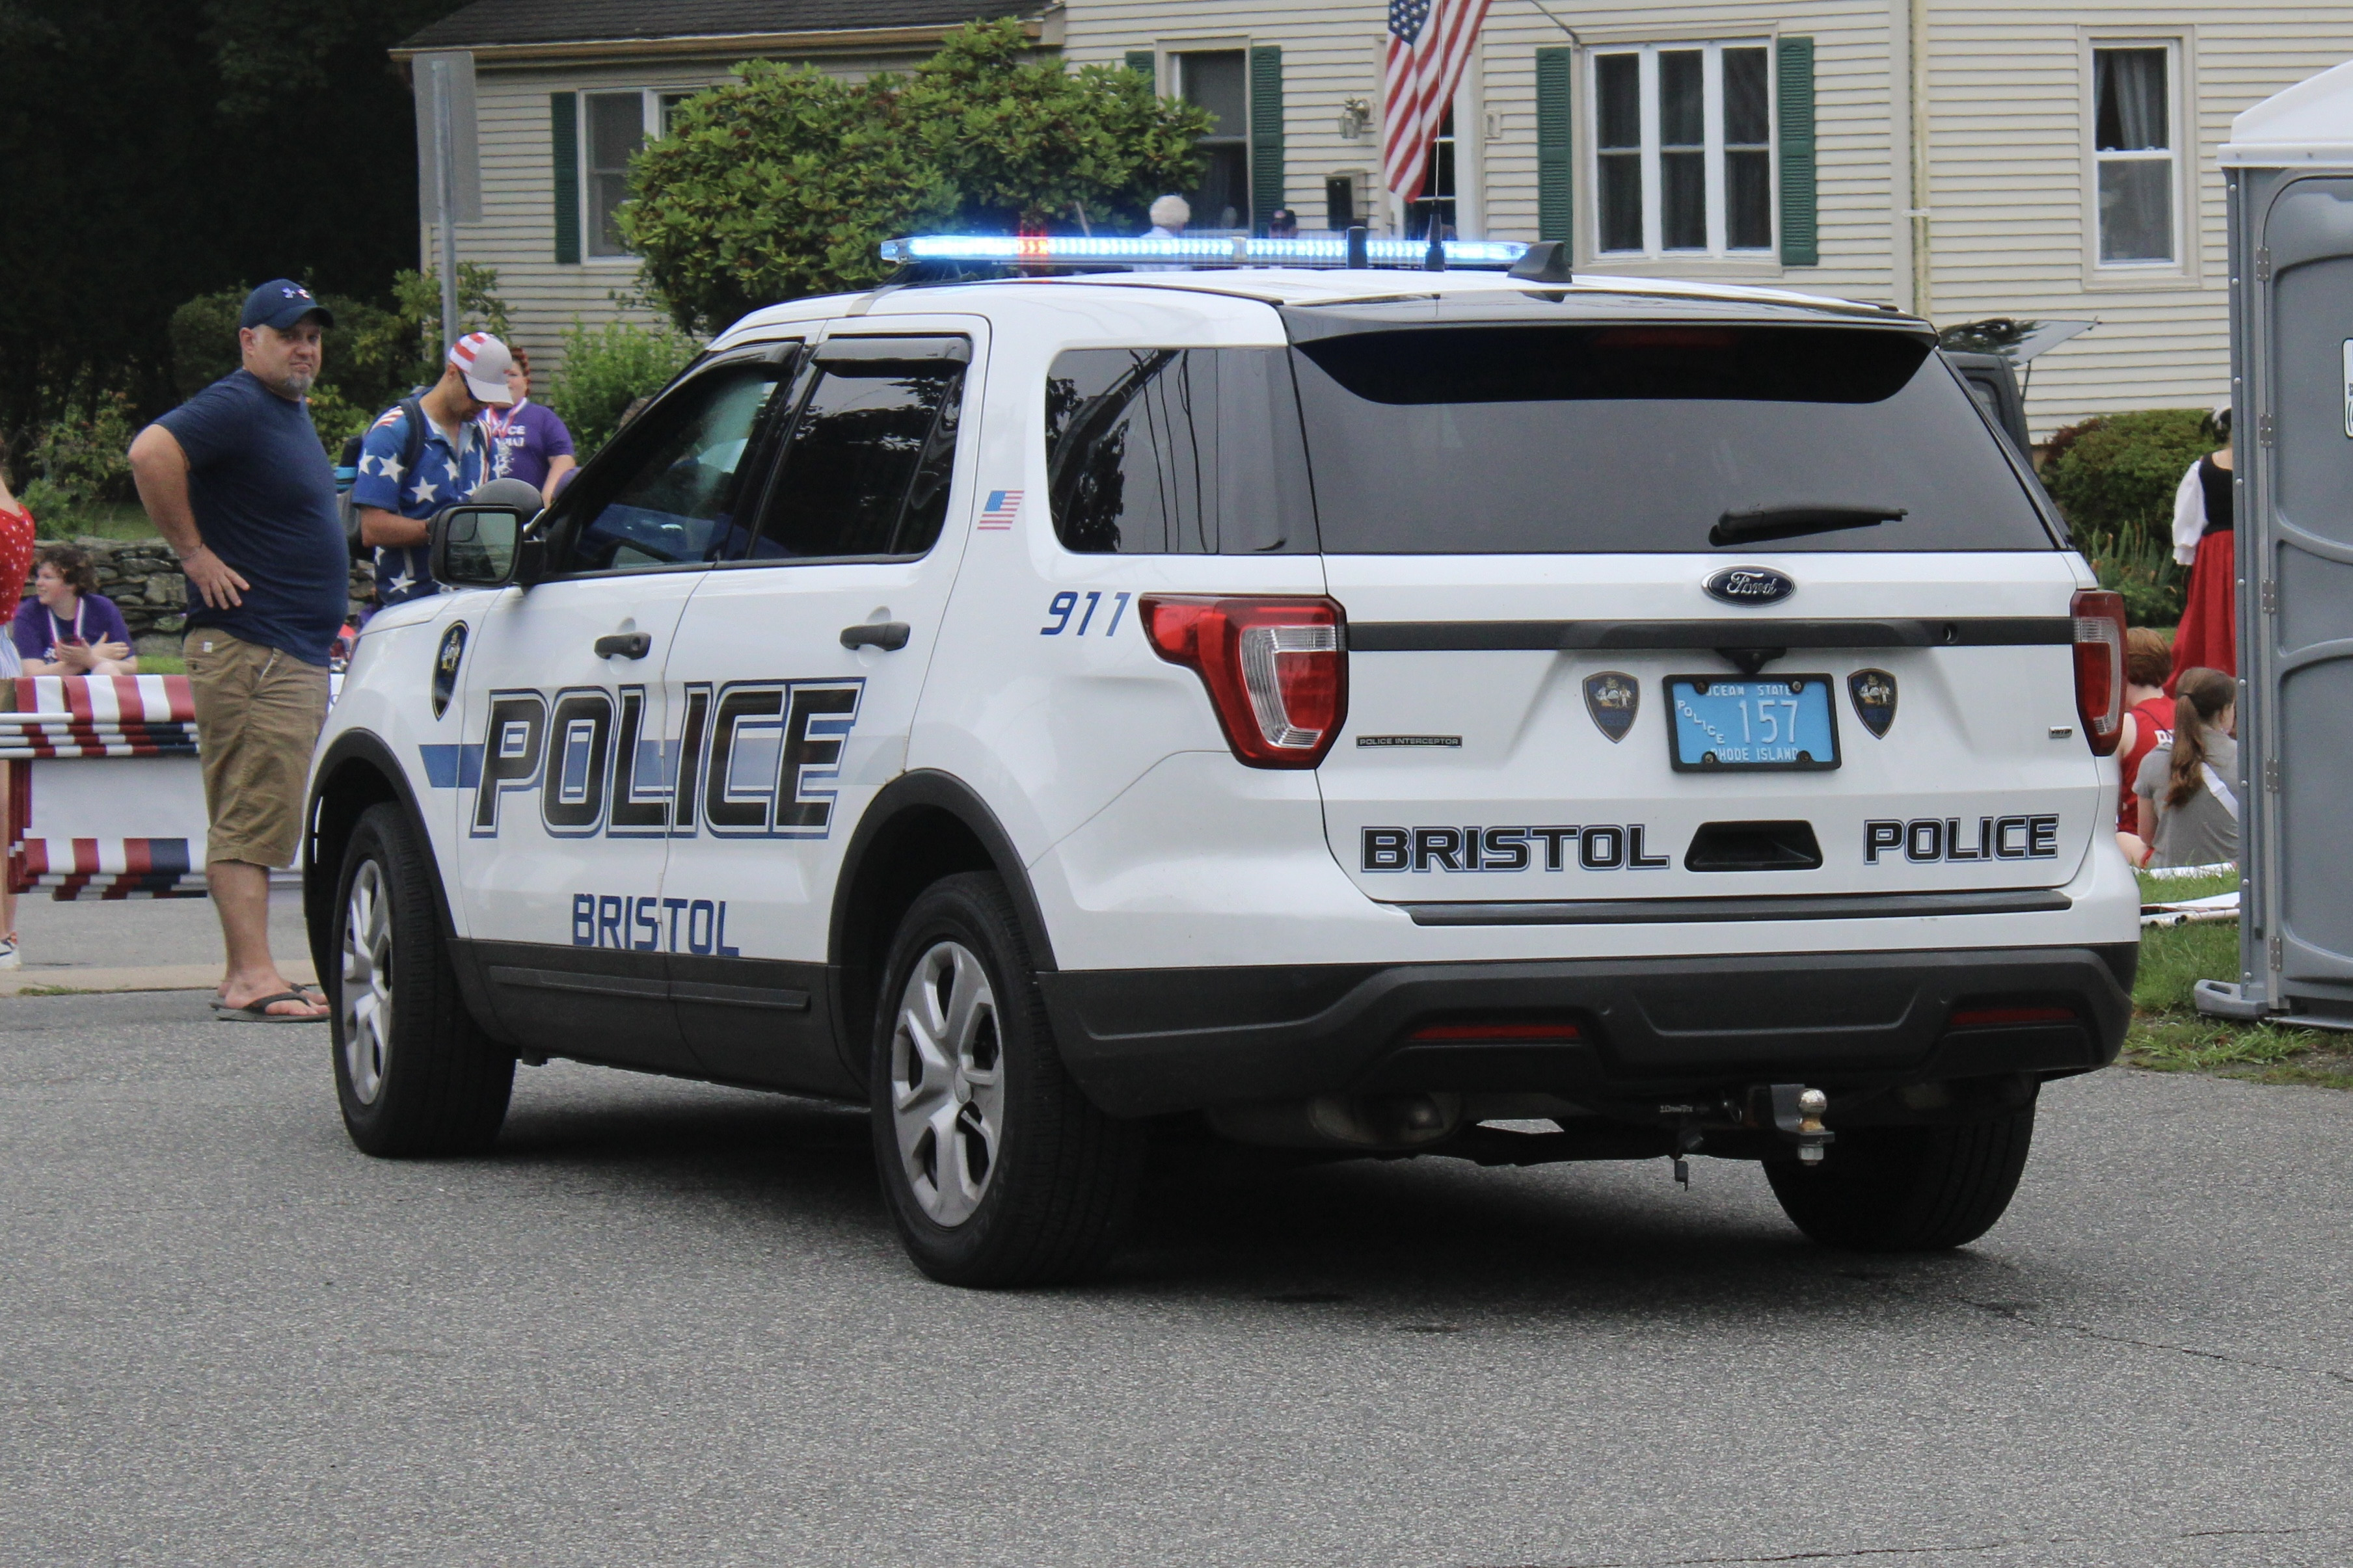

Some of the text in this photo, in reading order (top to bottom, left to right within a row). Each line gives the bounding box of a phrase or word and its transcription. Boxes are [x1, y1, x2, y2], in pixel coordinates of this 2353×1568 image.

[1726, 571, 1777, 596] Ford
[1040, 591, 1132, 637] 911
[1757, 684, 1793, 697] STATE
[1676, 700, 1725, 744] POLICE
[1738, 699, 1798, 744] 157
[469, 677, 867, 839] POLICE
[1756, 747, 1798, 760] ISLAND
[1361, 824, 1670, 873] BRISTOL
[1863, 814, 2060, 866] POLICE
[572, 894, 739, 957] BRISTOL
